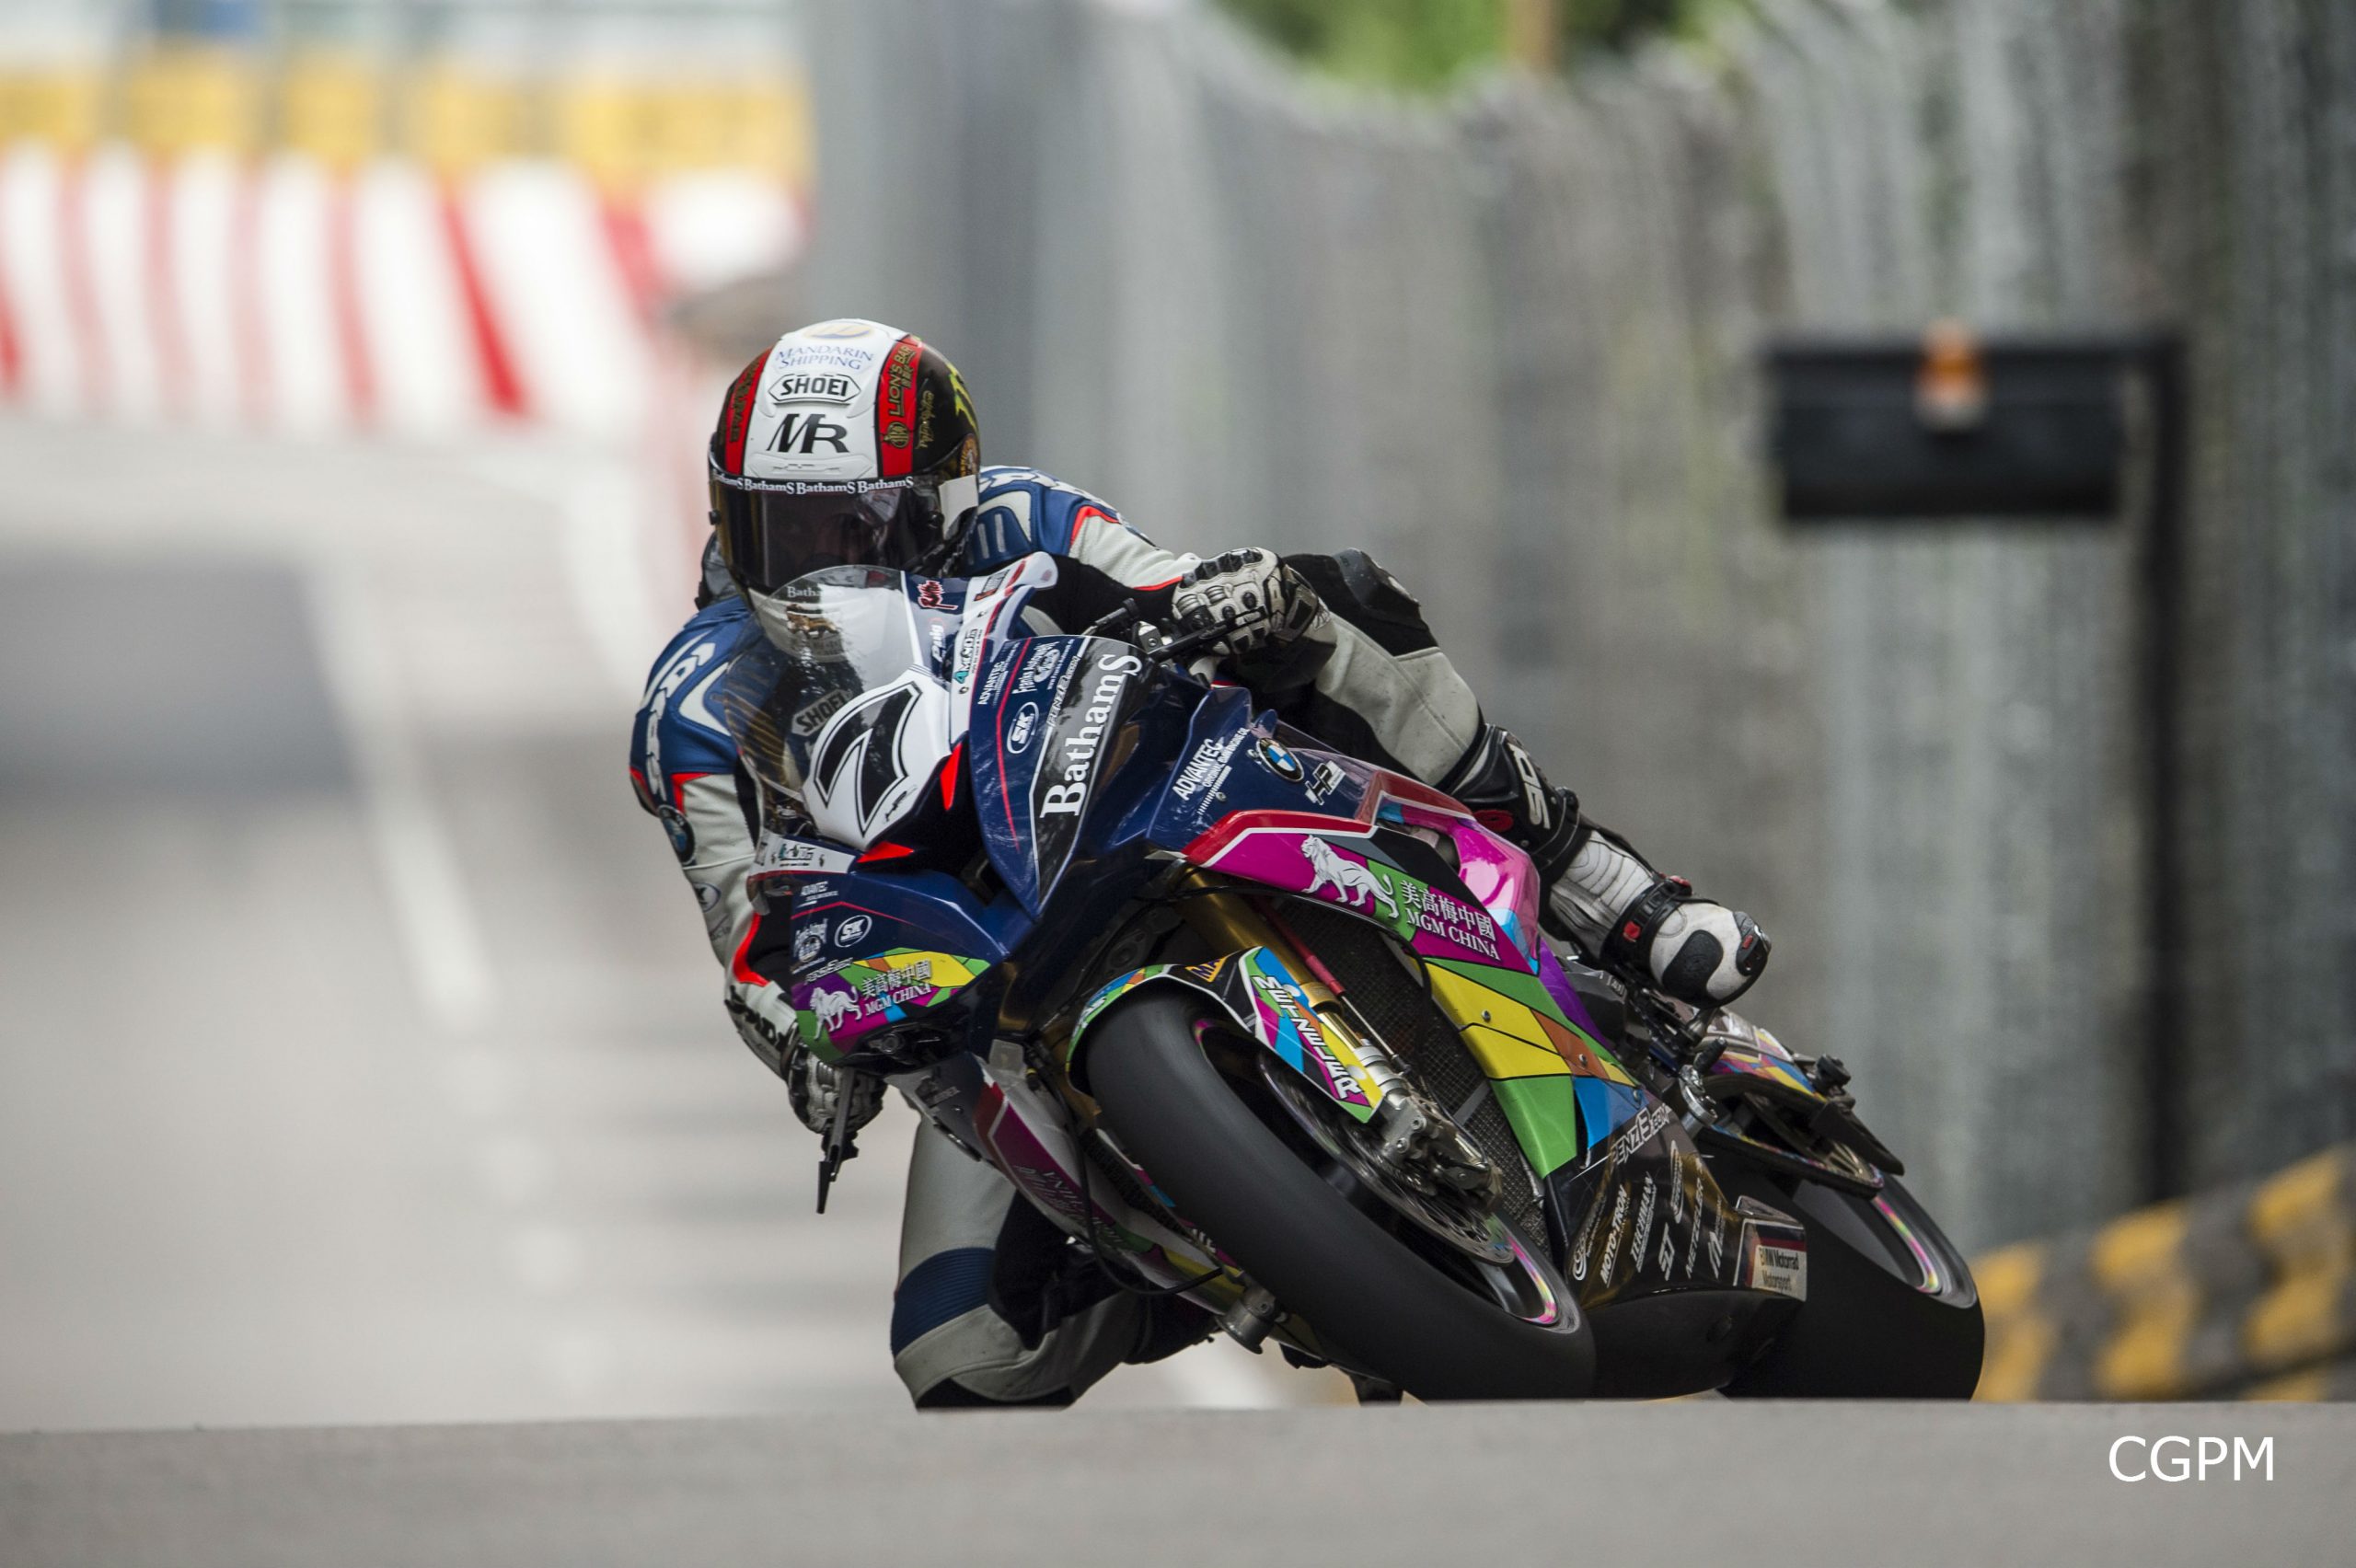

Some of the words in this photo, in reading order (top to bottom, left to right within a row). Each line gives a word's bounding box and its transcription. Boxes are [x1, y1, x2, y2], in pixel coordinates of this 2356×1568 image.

[776, 345, 873, 363] MANDARIN
[779, 354, 862, 370] SHIPPING
[780, 376, 849, 397] SHOEI
[766, 413, 850, 455] MR
[796, 480, 857, 495] BathamS
[857, 476, 914, 494] BathamS
[977, 661, 1005, 705] ADVANTEC
[795, 692, 846, 732] SHOEI
[1040, 653, 1142, 819] BathamS
[1172, 738, 1224, 801] ADVANTEC
[1401, 880, 1496, 941] 美高梅中國
[1406, 908, 1446, 938] MGM
[1448, 926, 1502, 962] CHINA
[862, 959, 931, 1001] 美高梅中國
[864, 995, 893, 1016] MGM
[893, 983, 932, 1004] CHINA
[1600, 1183, 1627, 1286] MOTO-TRON
[1686, 1177, 1703, 1279] METZELER
[1774, 1249, 1799, 1271] Motorrad
